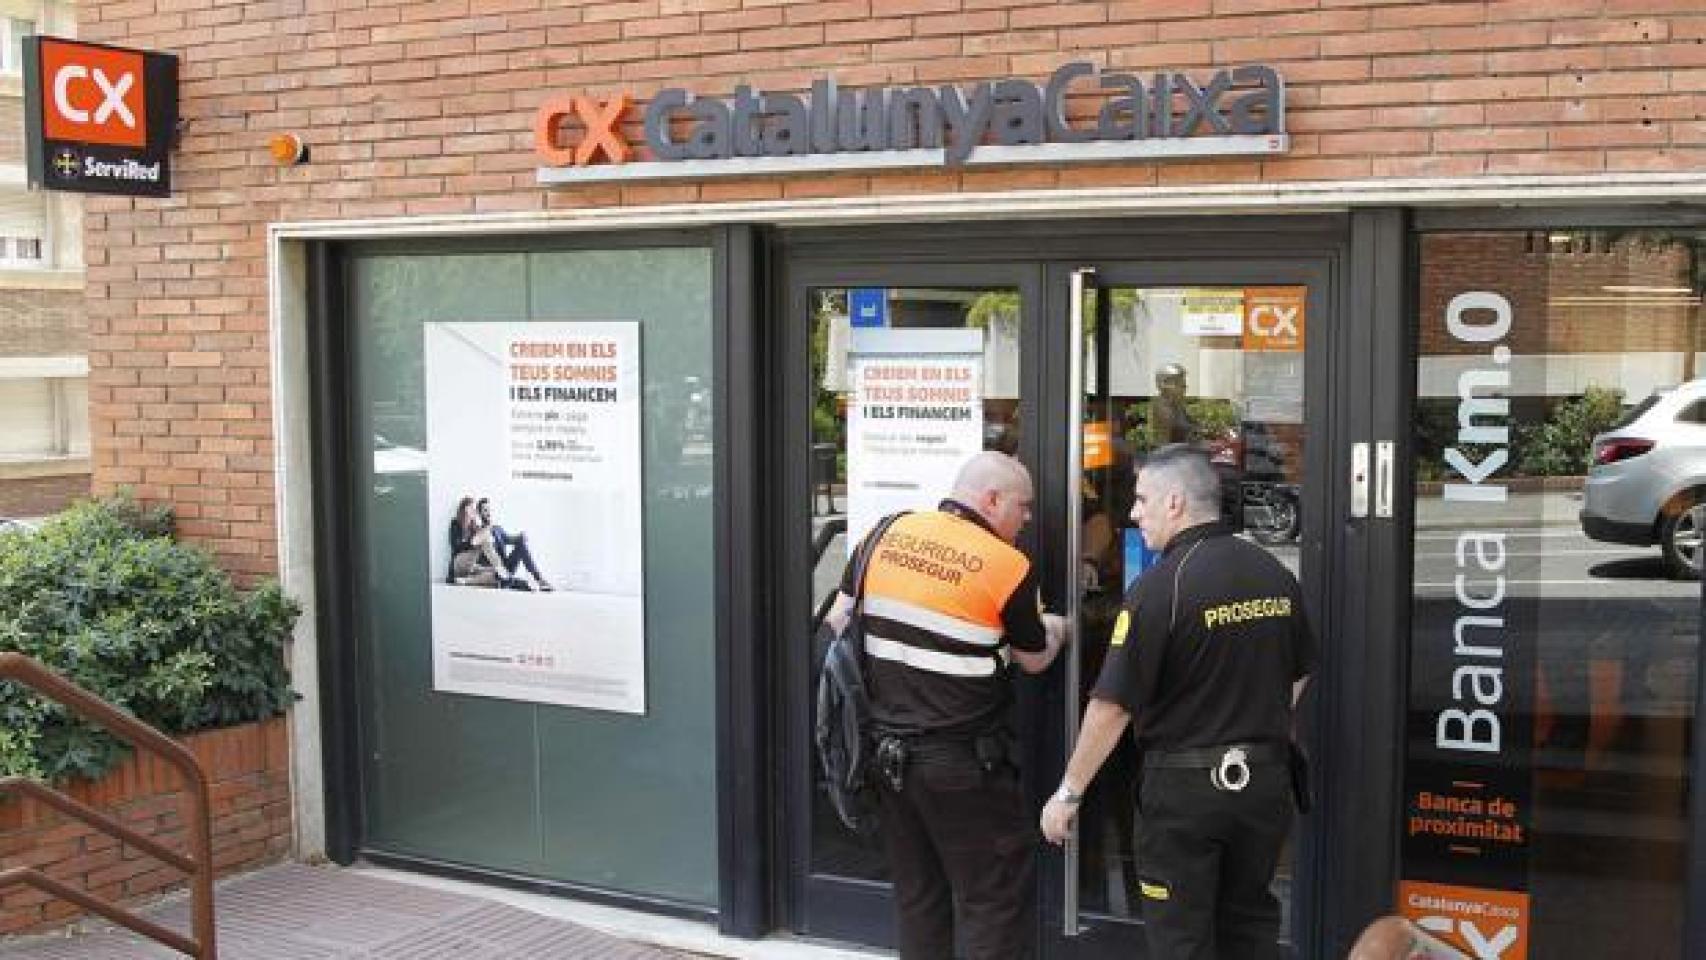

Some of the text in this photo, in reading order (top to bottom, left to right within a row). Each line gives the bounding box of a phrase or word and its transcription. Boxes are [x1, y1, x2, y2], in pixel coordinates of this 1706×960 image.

[54, 65, 136, 130] CX
[534, 61, 1286, 167] CX CatalunyaCaixa
[84, 155, 161, 182] ServiRed
[1250, 304, 1298, 337] CX
[509, 341, 617, 358] CREIEM EN ELS
[510, 363, 617, 382] TEUS SOMNIS
[863, 366, 972, 381] CREIEM EN ELS
[509, 386, 617, 402] I ELS FINANCEM
[864, 386, 971, 403] TEUS SOMNIS
[871, 406, 895, 419] ELS
[897, 407, 972, 421] FINANCEM
[882, 530, 984, 573] SEGURIDAD
[879, 549, 962, 586] PROSEGUR
[1204, 597, 1292, 630] PROSEGUR
[1436, 532, 1506, 752] Banca
[1419, 792, 1515, 818] Banca de
[1410, 815, 1524, 842] proximitat
